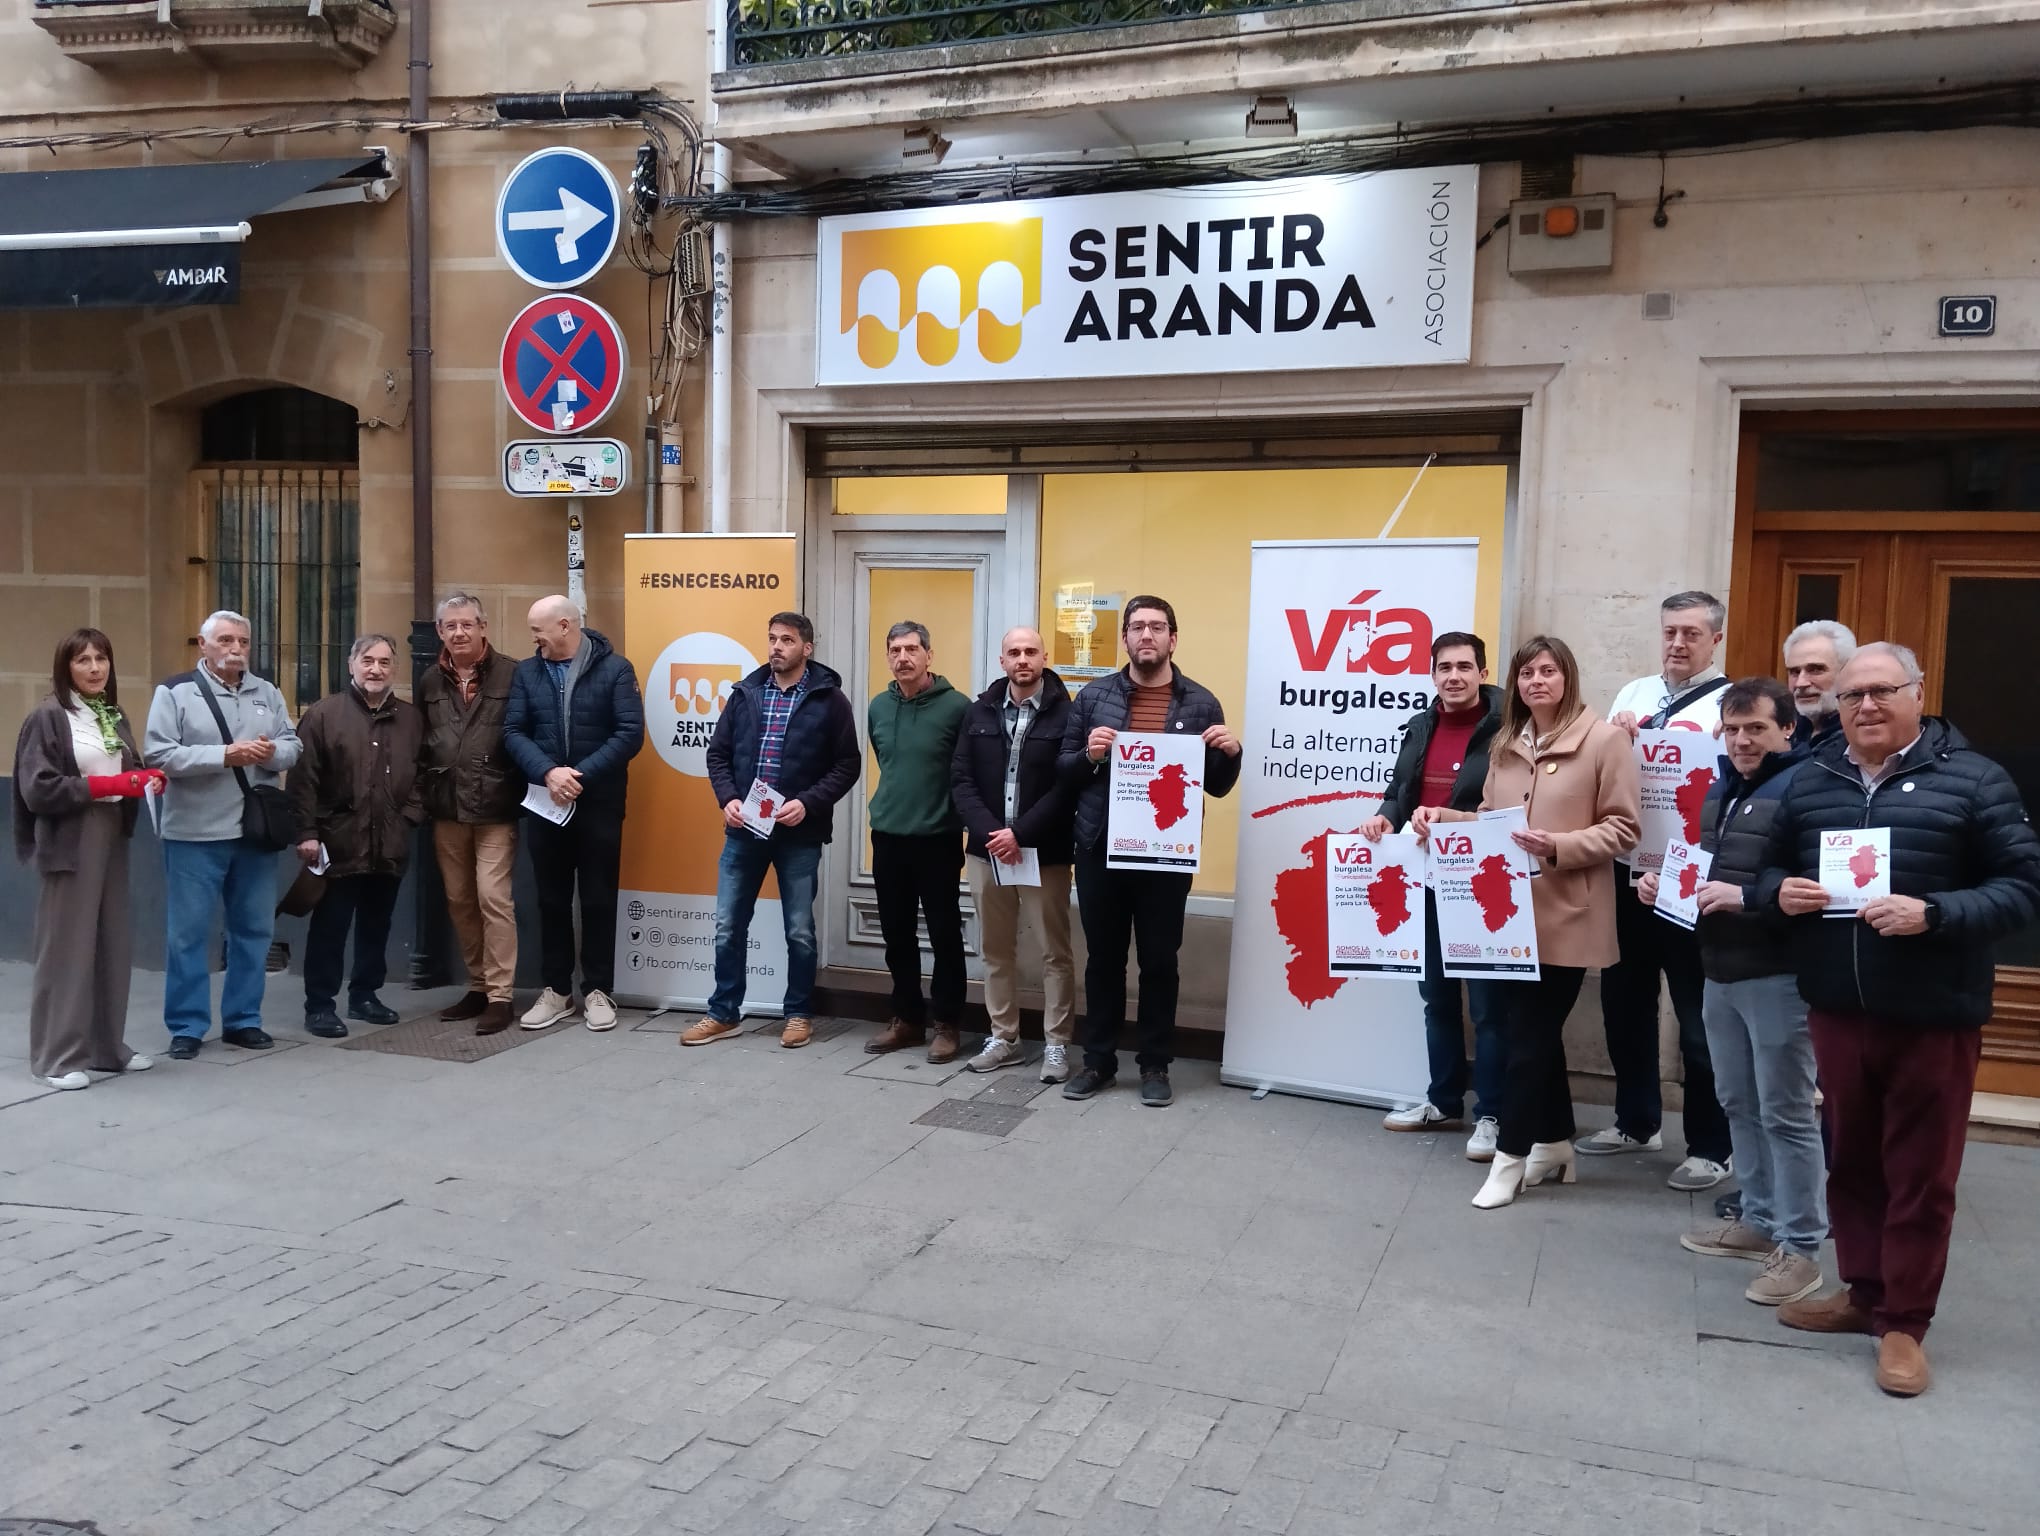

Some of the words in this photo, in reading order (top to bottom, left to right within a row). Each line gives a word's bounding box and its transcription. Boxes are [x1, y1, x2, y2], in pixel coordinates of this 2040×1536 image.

[1067, 212, 1325, 282] SENTIR
[1424, 181, 1451, 346] ASOCIACIÓN
[165, 266, 229, 286] AMBAR
[1064, 274, 1376, 343] ARANDA
[1953, 305, 1984, 323] 10
[640, 572, 780, 590] #ESNECESARIO
[1284, 589, 1434, 676] vía
[1279, 681, 1429, 714] burgalesa
[676, 720, 718, 734] SENT
[1271, 728, 1295, 750] La
[1119, 741, 1155, 761] vía
[1642, 739, 1682, 764] vía
[1118, 762, 1155, 770] burgalesa
[1641, 763, 1682, 774] burgalesa
[1335, 843, 1372, 865] vía
[1435, 832, 1473, 855] vía
[1334, 865, 1373, 874] burgalesa
[1437, 856, 1475, 866] burgalesa
